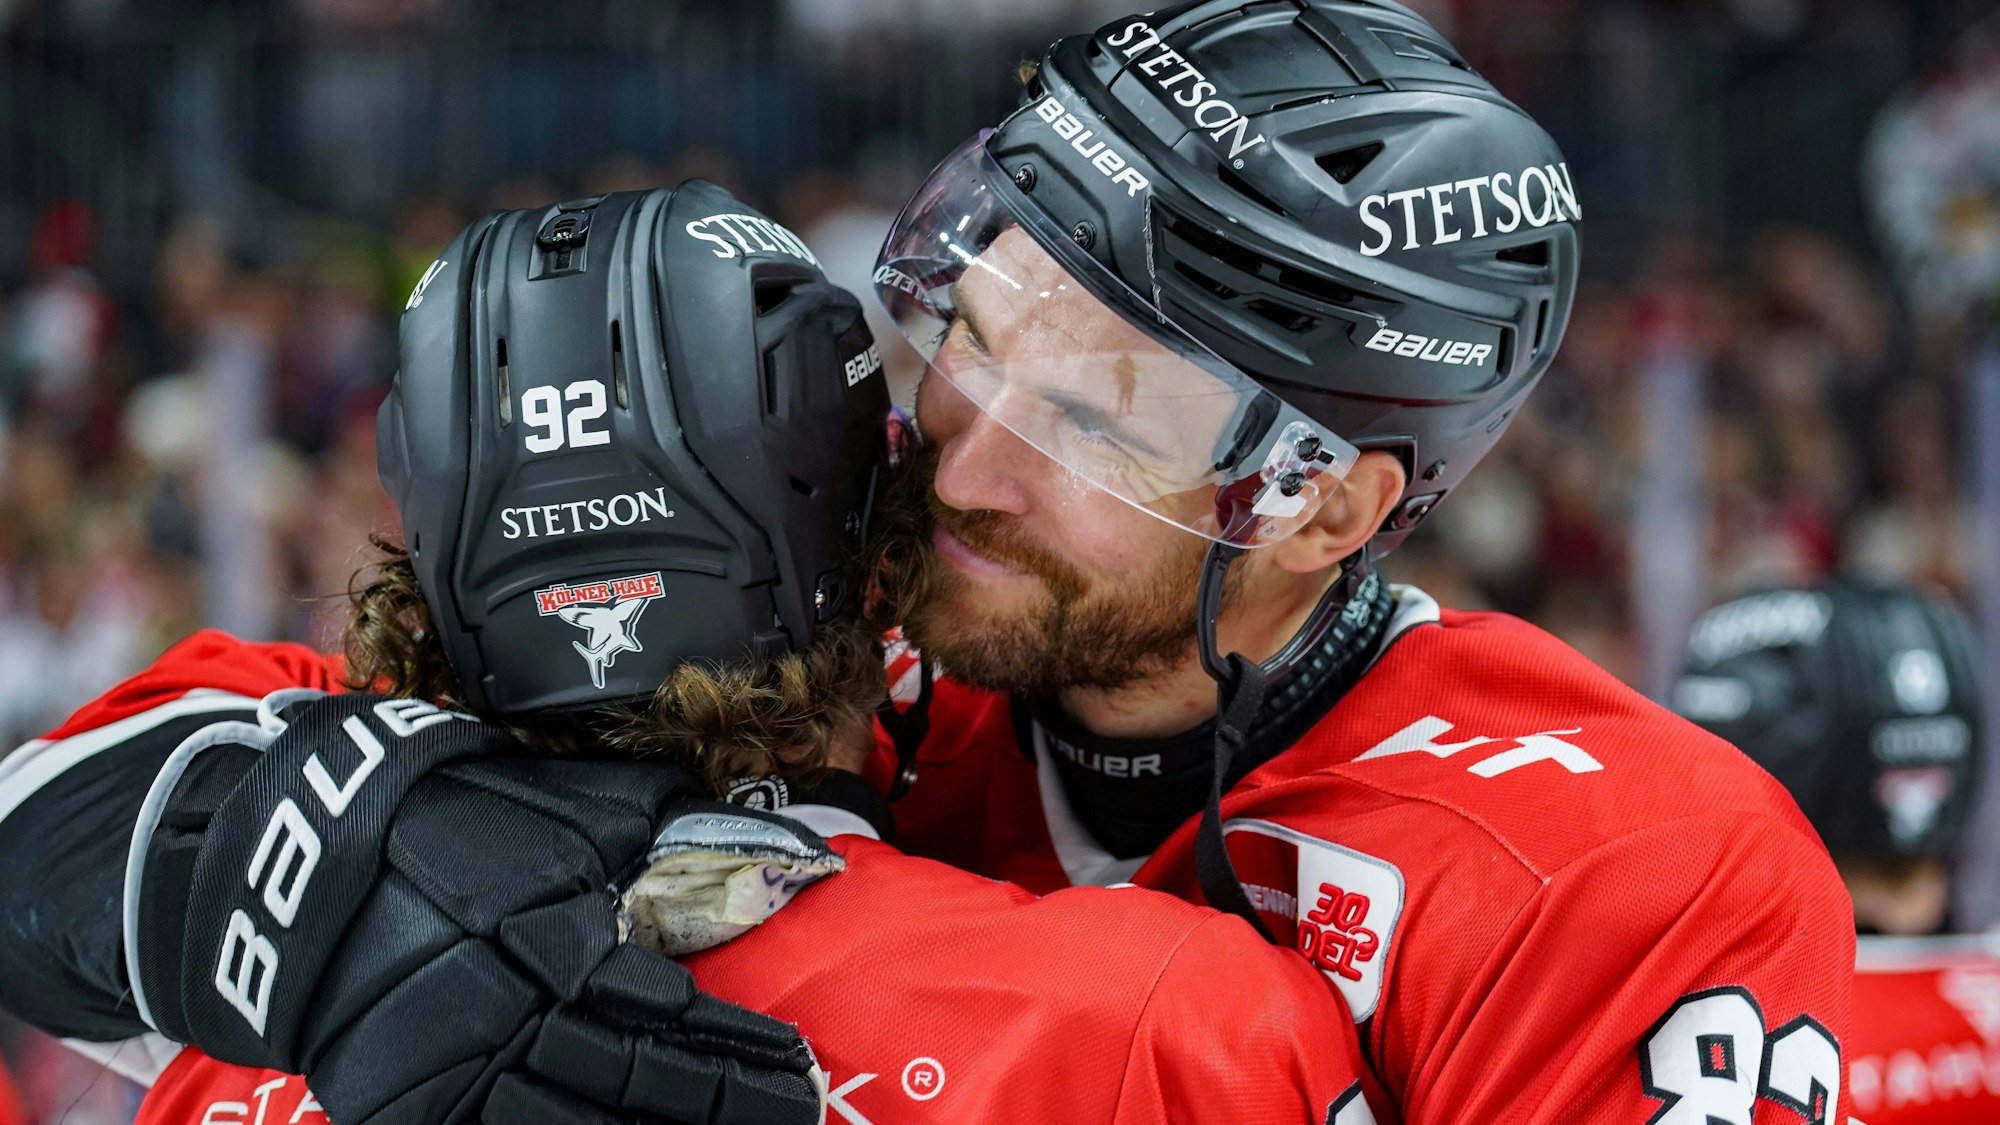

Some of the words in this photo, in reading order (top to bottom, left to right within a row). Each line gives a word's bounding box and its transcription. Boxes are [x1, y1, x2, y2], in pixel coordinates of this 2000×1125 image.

[1035, 97, 1150, 197] BAUER
[686, 213, 824, 271] STETSO
[1359, 162, 1582, 257] STETSON
[1365, 328, 1492, 366] BAUER
[521, 379, 611, 453] 92
[538, 583, 611, 613] KÖLNER
[612, 574, 662, 600] HAIE
[214, 698, 481, 1038] BAUE
[1307, 882, 1370, 932] 30
